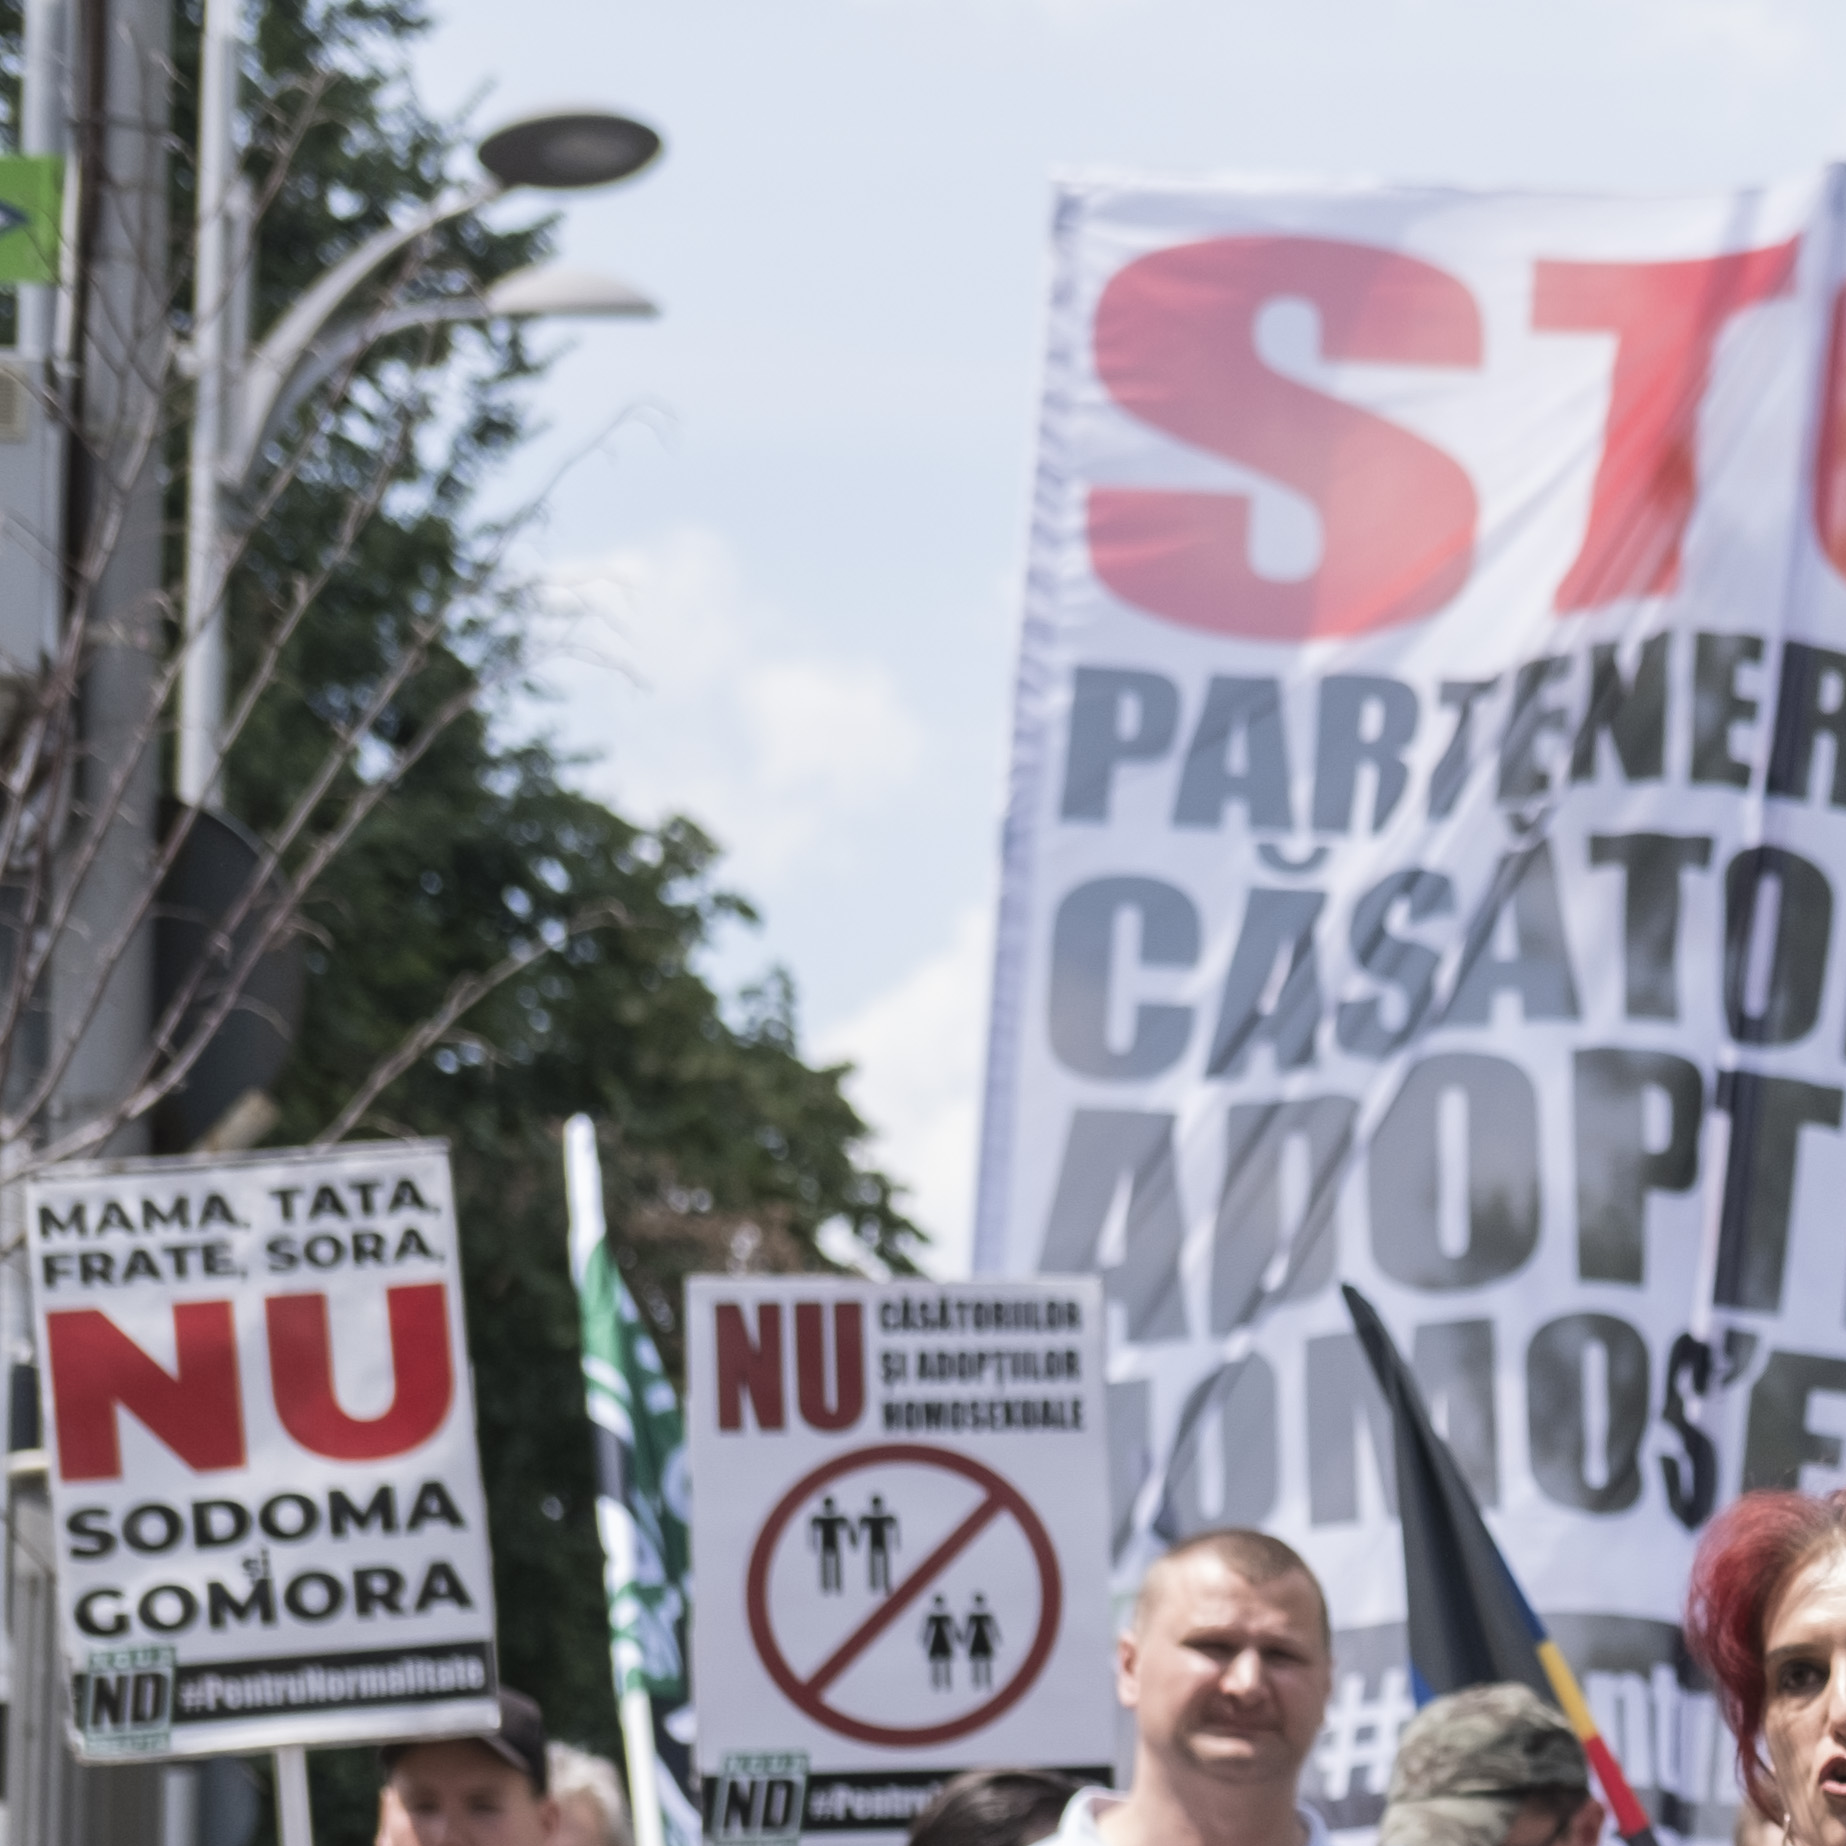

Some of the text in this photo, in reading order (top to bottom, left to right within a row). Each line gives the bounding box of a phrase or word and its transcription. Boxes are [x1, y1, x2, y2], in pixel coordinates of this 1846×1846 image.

[45, 1280, 456, 1484] NU
[715, 1301, 866, 1433] NU
[64, 1479, 467, 1561] SODOMA
[72, 1561, 474, 1640] GOMORA
